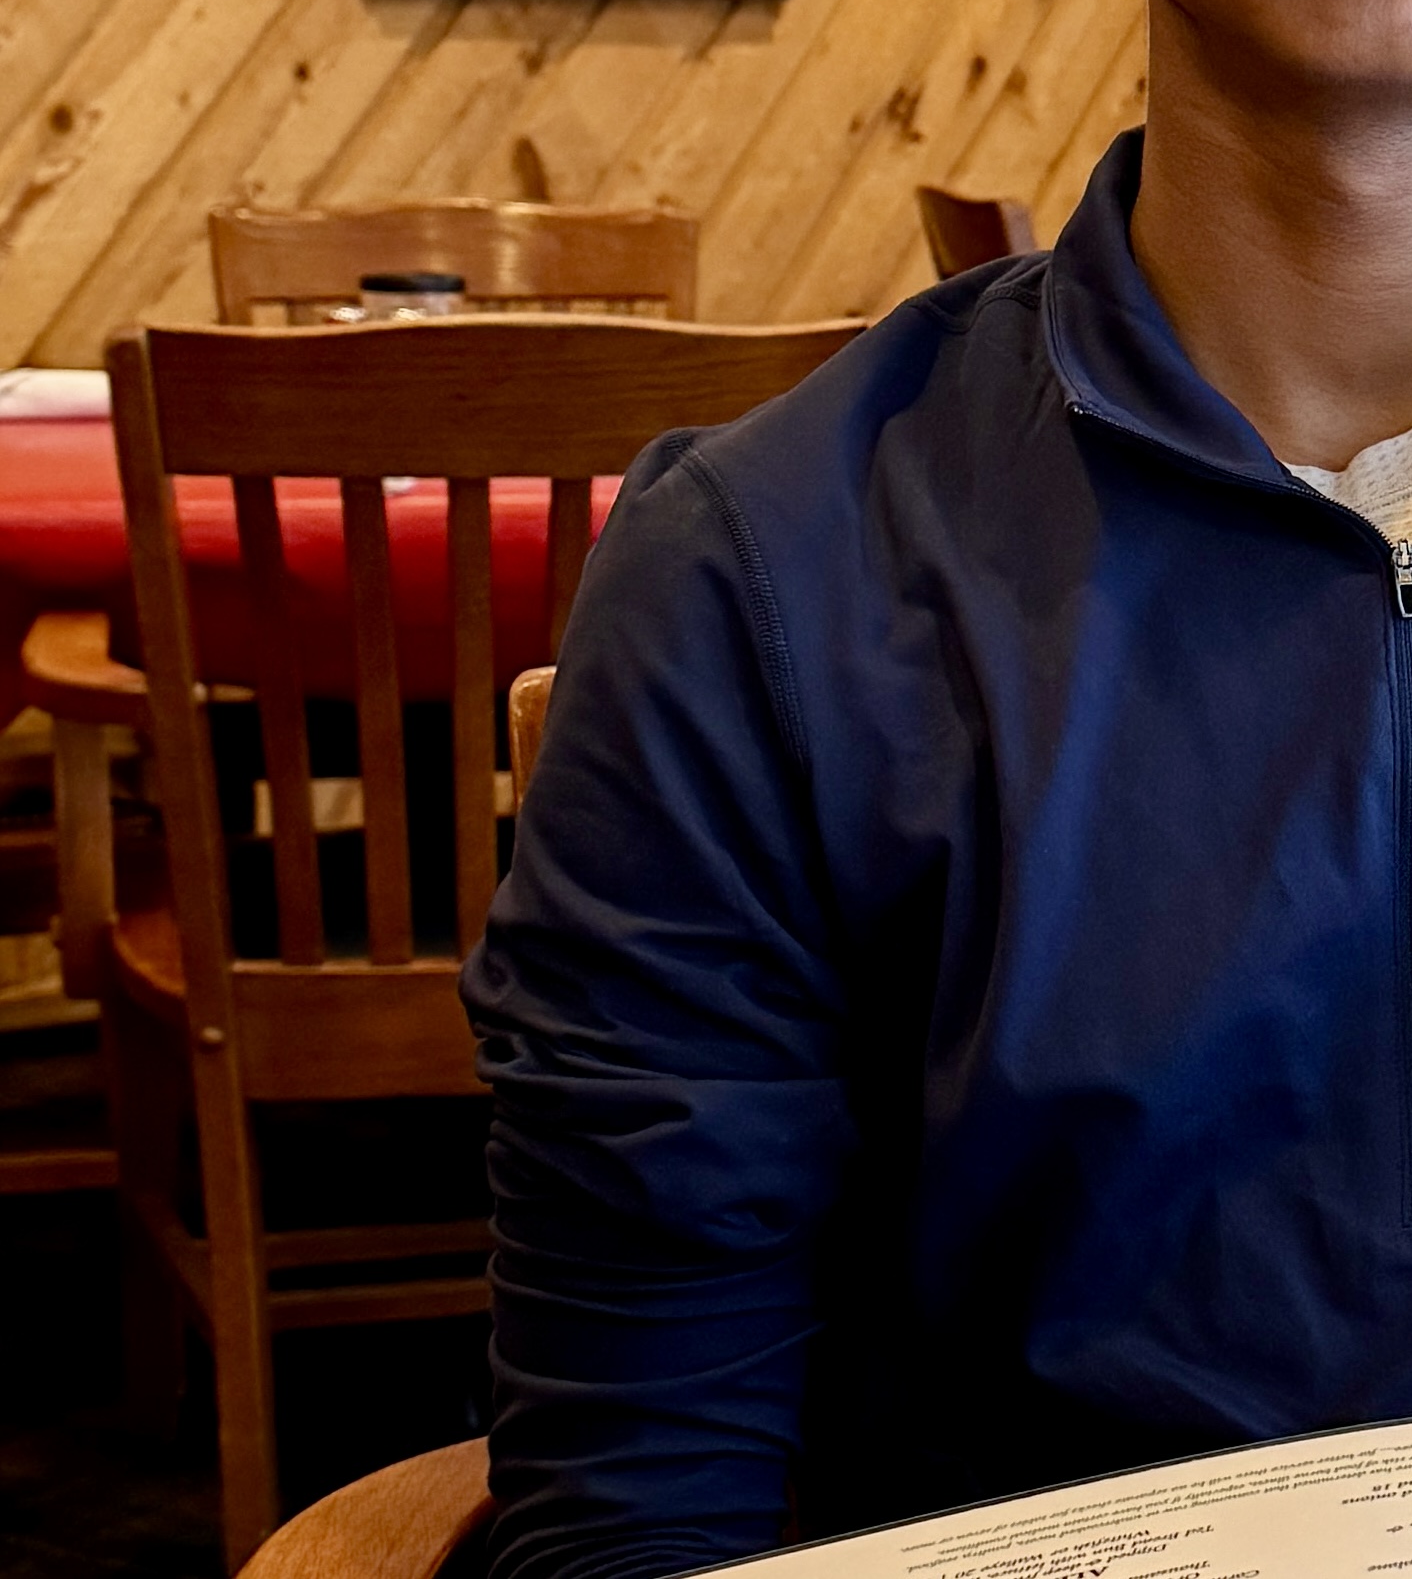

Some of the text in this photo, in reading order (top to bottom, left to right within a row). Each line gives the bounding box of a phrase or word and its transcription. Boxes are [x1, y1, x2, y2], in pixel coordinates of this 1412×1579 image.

[1341, 1491, 1397, 1505] onions
[1185, 1524, 1214, 1538] Ted
[1073, 1529, 1149, 1550] Whitefish
[1131, 1531, 1178, 1548] Bread
[1093, 1543, 1124, 1555] Bun
[1106, 1544, 1167, 1564] Dipped
[1050, 1552, 1086, 1565] with
